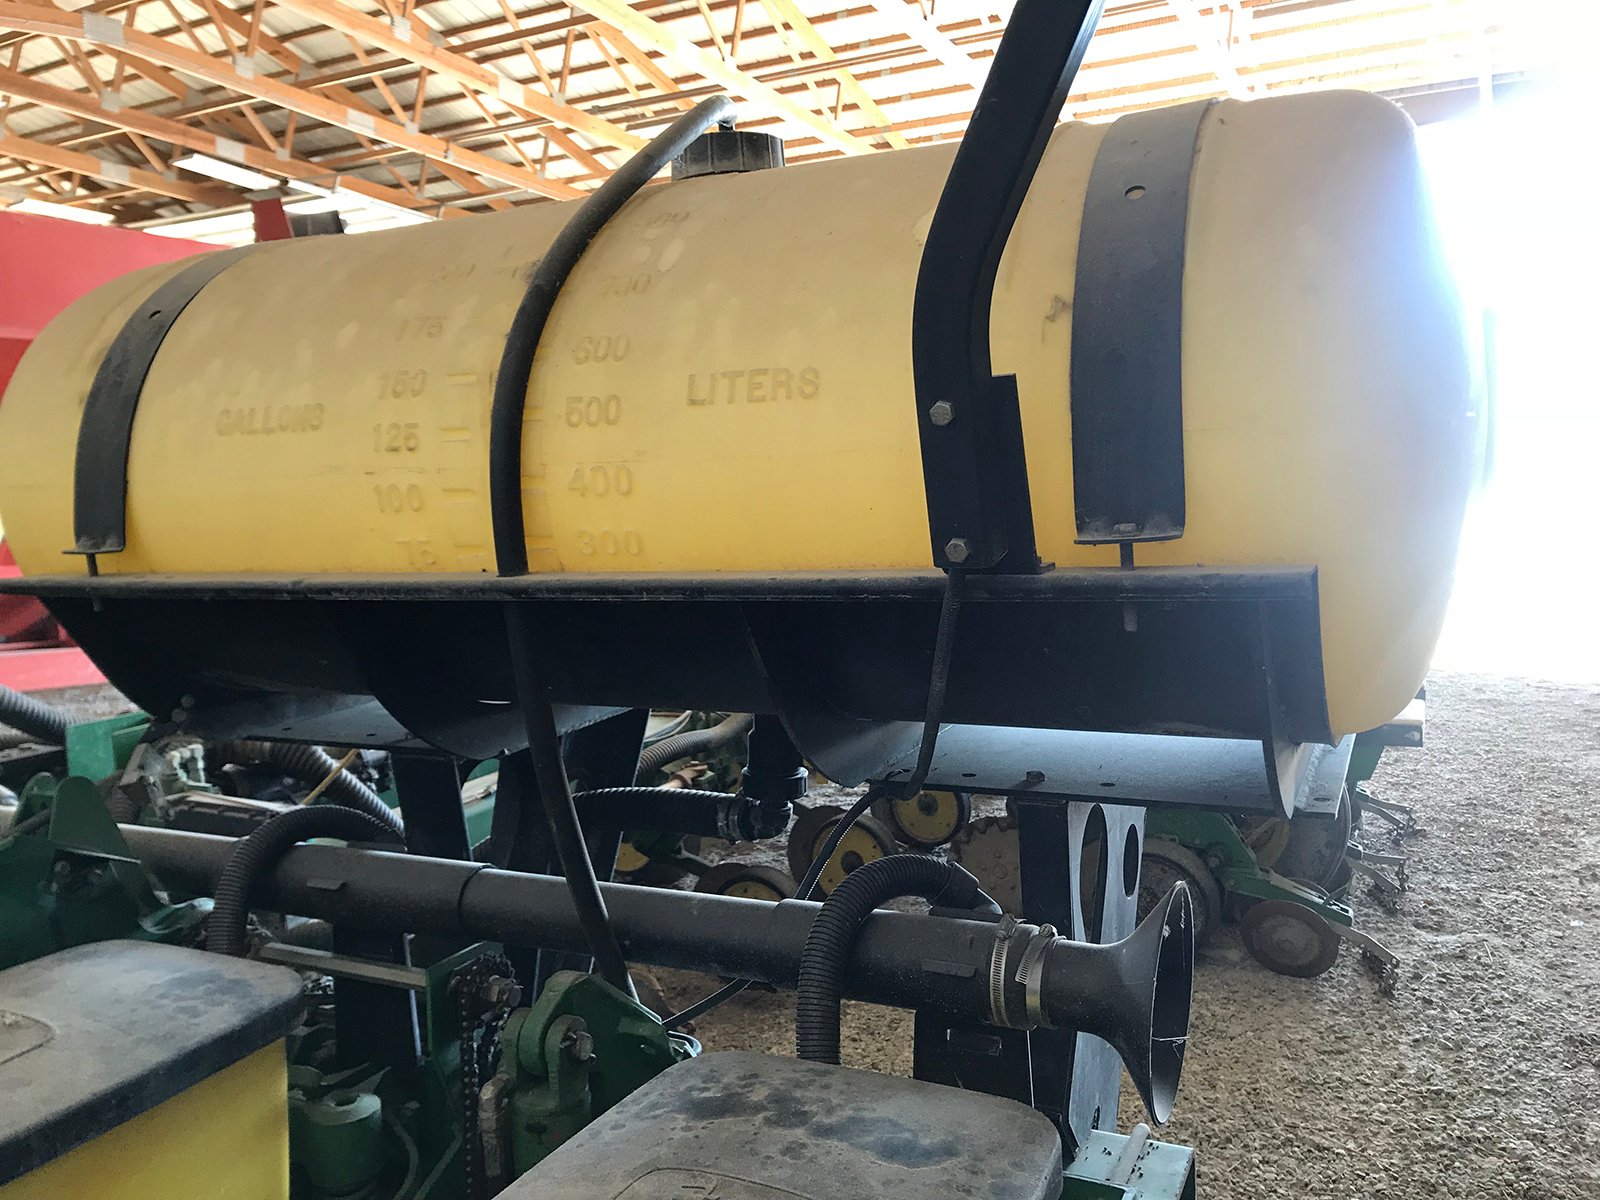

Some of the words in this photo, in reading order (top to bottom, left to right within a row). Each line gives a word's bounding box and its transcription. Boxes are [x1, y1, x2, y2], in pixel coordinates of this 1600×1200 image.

[571, 335, 632, 366] 600
[687, 366, 820, 406] LITERS
[564, 394, 622, 428] 500
[372, 422, 420, 453] 125
[567, 464, 633, 498] 400
[372, 483, 424, 513] 100
[576, 527, 644, 556] 300
